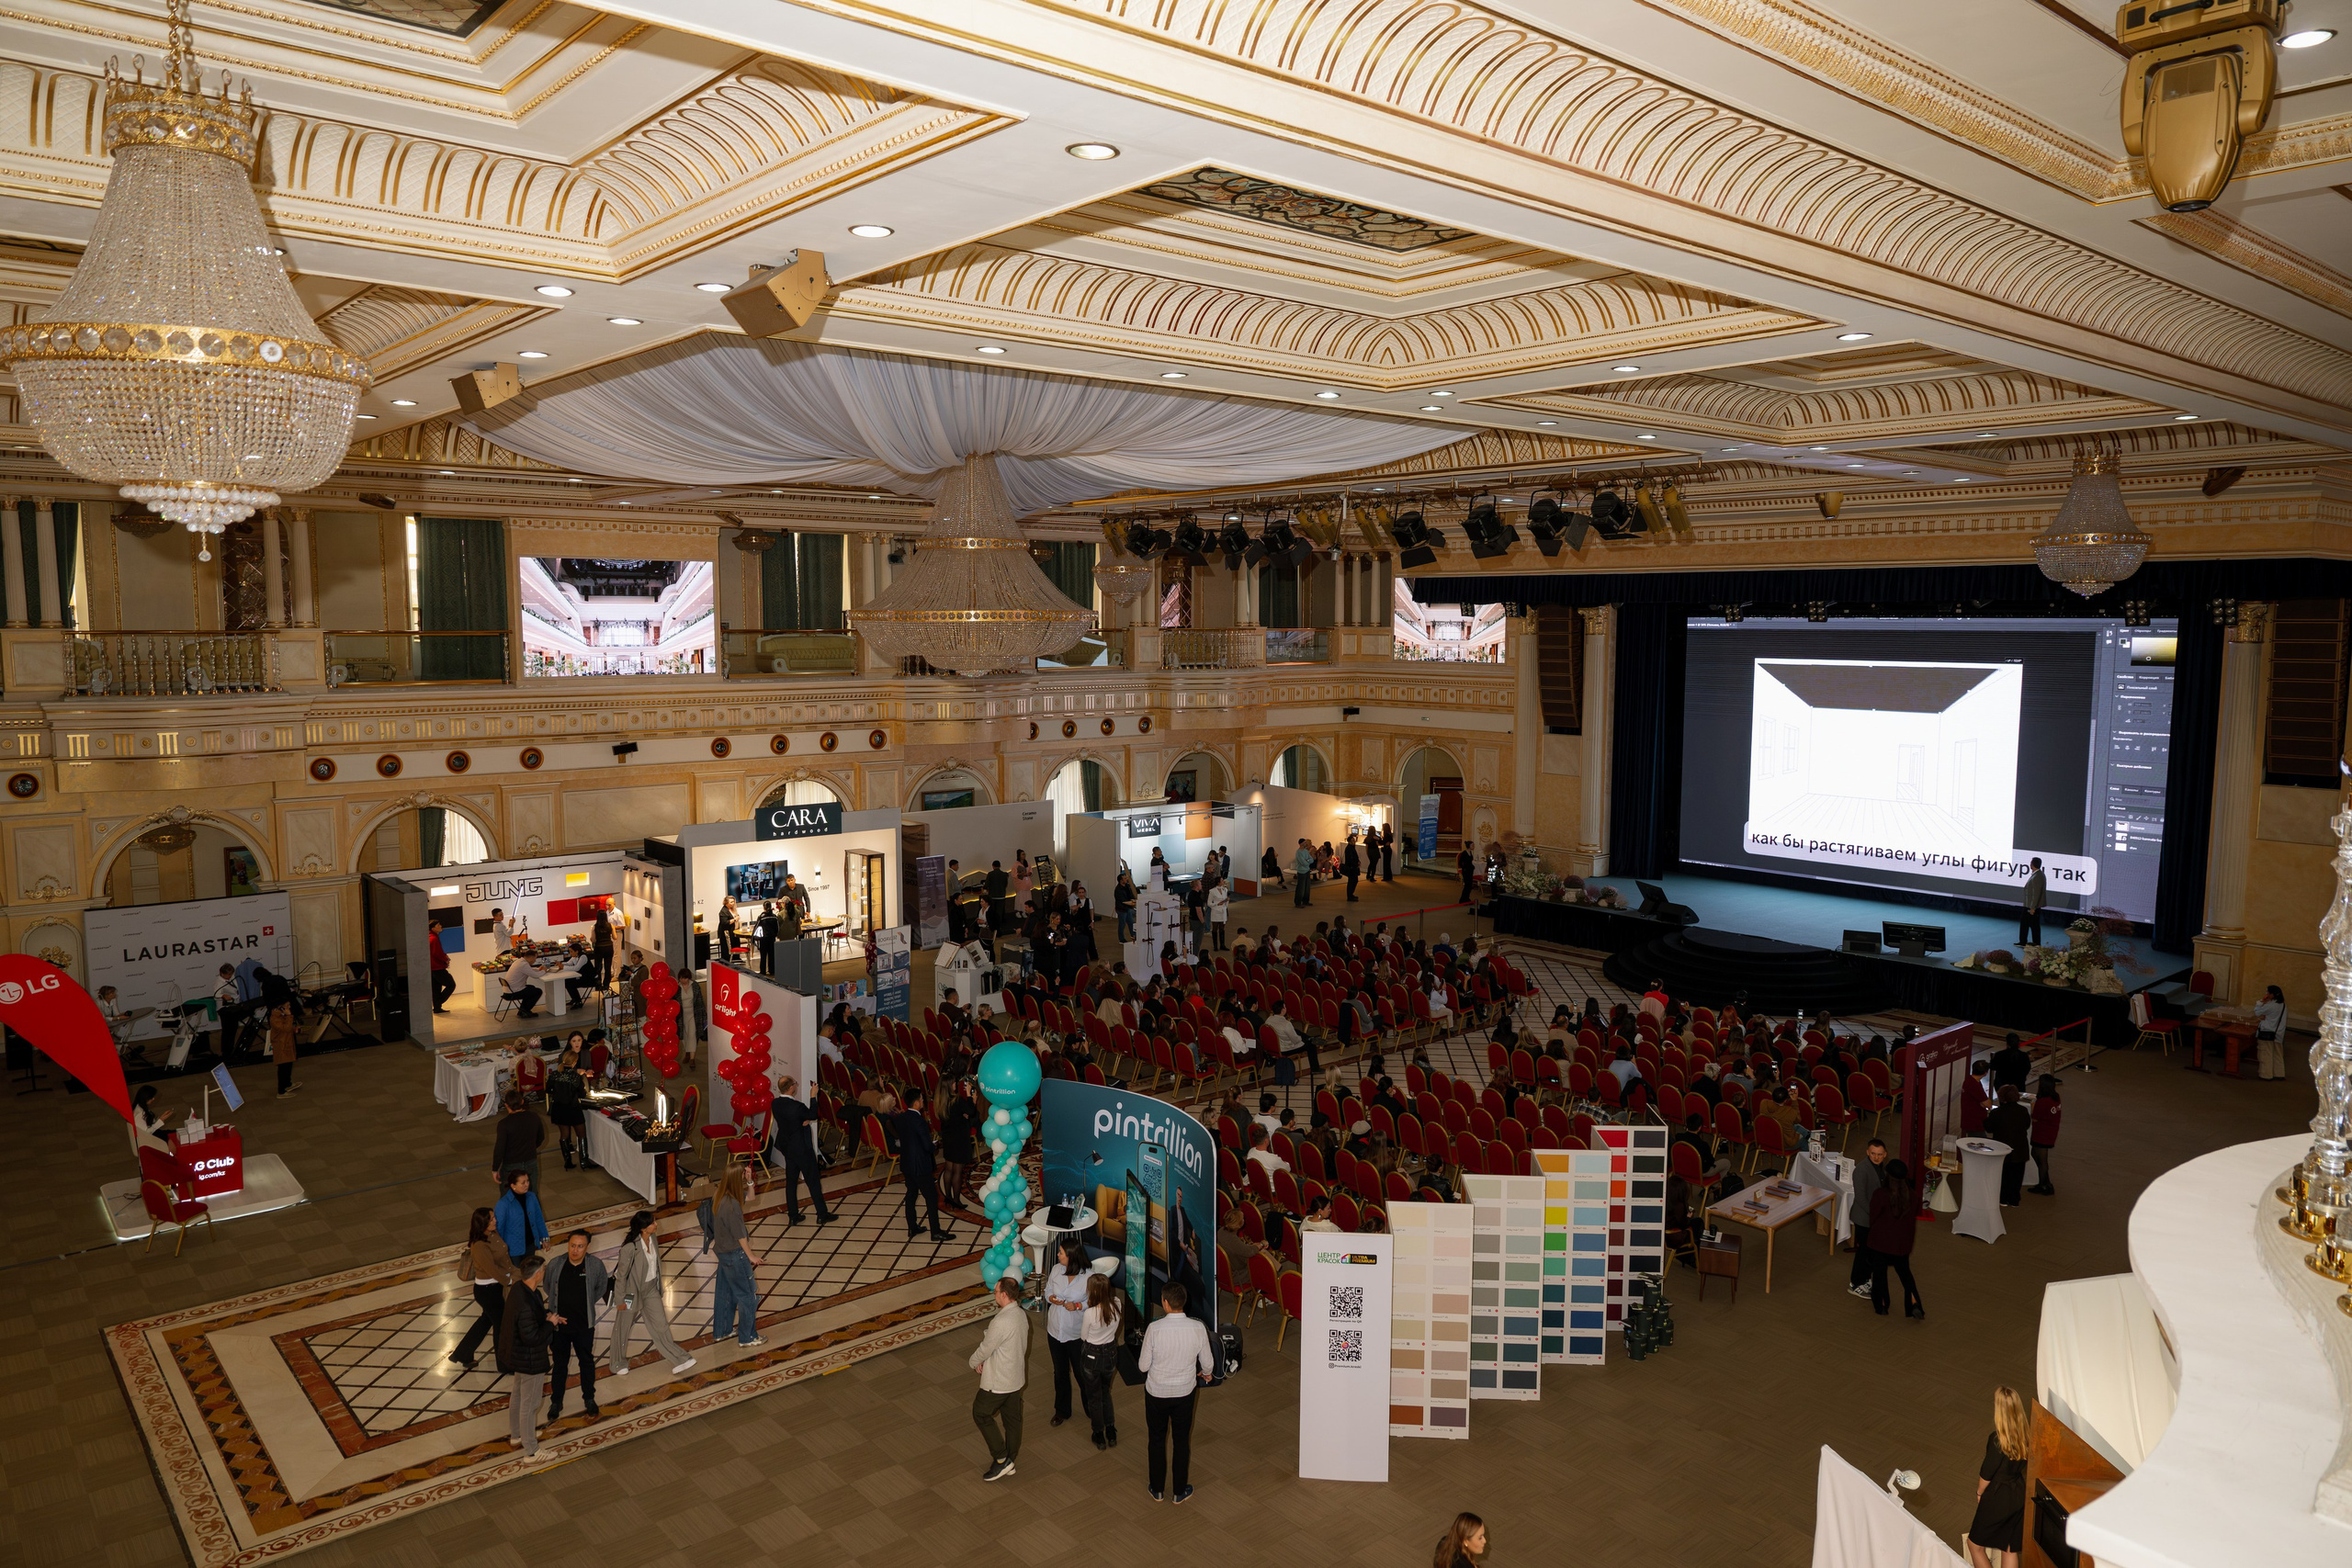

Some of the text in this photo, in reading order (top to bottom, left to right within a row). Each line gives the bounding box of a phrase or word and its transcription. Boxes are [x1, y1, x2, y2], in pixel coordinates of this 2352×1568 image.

[771, 807, 828, 829] CARA
[1133, 818, 1160, 829] VIVA
[773, 828, 829, 837] hardwood
[1751, 832, 2086, 883] как бы растягиваем углы фигур так
[466, 876, 543, 903] JUNG
[808, 885, 820, 893] Since
[123, 934, 259, 963] LAURASTAR
[26, 974, 61, 995] LG
[715, 1003, 737, 1017] arlight
[1093, 1102, 1203, 1179] pintrillion
[189, 1156, 235, 1172] G Club
[198, 1170, 226, 1180] lg.com/kz
